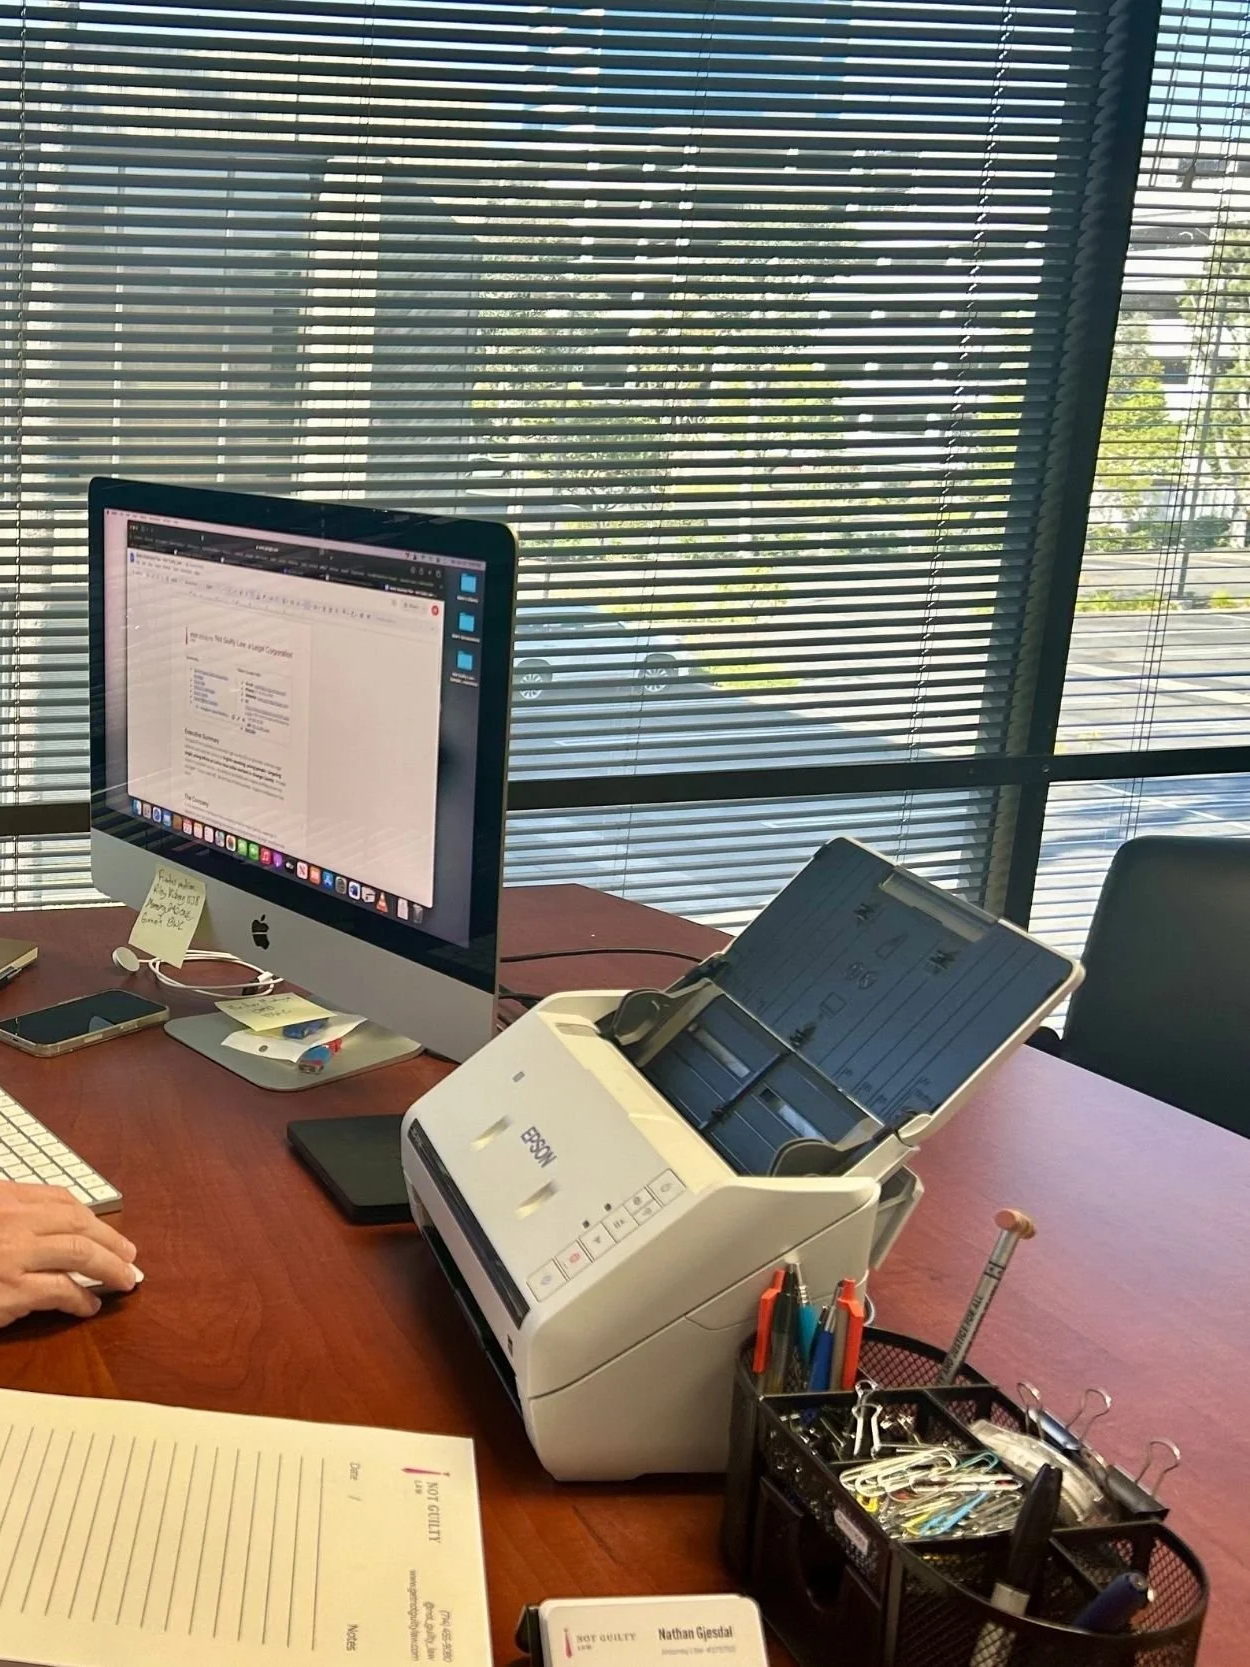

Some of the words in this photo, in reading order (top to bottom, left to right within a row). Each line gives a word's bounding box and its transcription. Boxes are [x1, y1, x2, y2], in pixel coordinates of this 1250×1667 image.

[202, 732, 220, 744] Summary
[192, 796, 209, 808] Company
[520, 1126, 557, 1168] EPSON
[953, 1323, 970, 1359] JUSTICE
[965, 1309, 977, 1326] FOR
[972, 1295, 983, 1310] ALL
[349, 1462, 361, 1481] Date
[415, 1480, 423, 1494] LAW
[427, 1481, 439, 1502] NOT
[428, 1504, 441, 1543] GUILTY
[346, 1624, 359, 1652] Notes
[423, 1600, 436, 1662] @not_guilty_law
[576, 1634, 597, 1643] NOT
[600, 1632, 637, 1643] GUILTY
[658, 1627, 694, 1641] Nathan
[696, 1624, 733, 1643] Gjesdal
